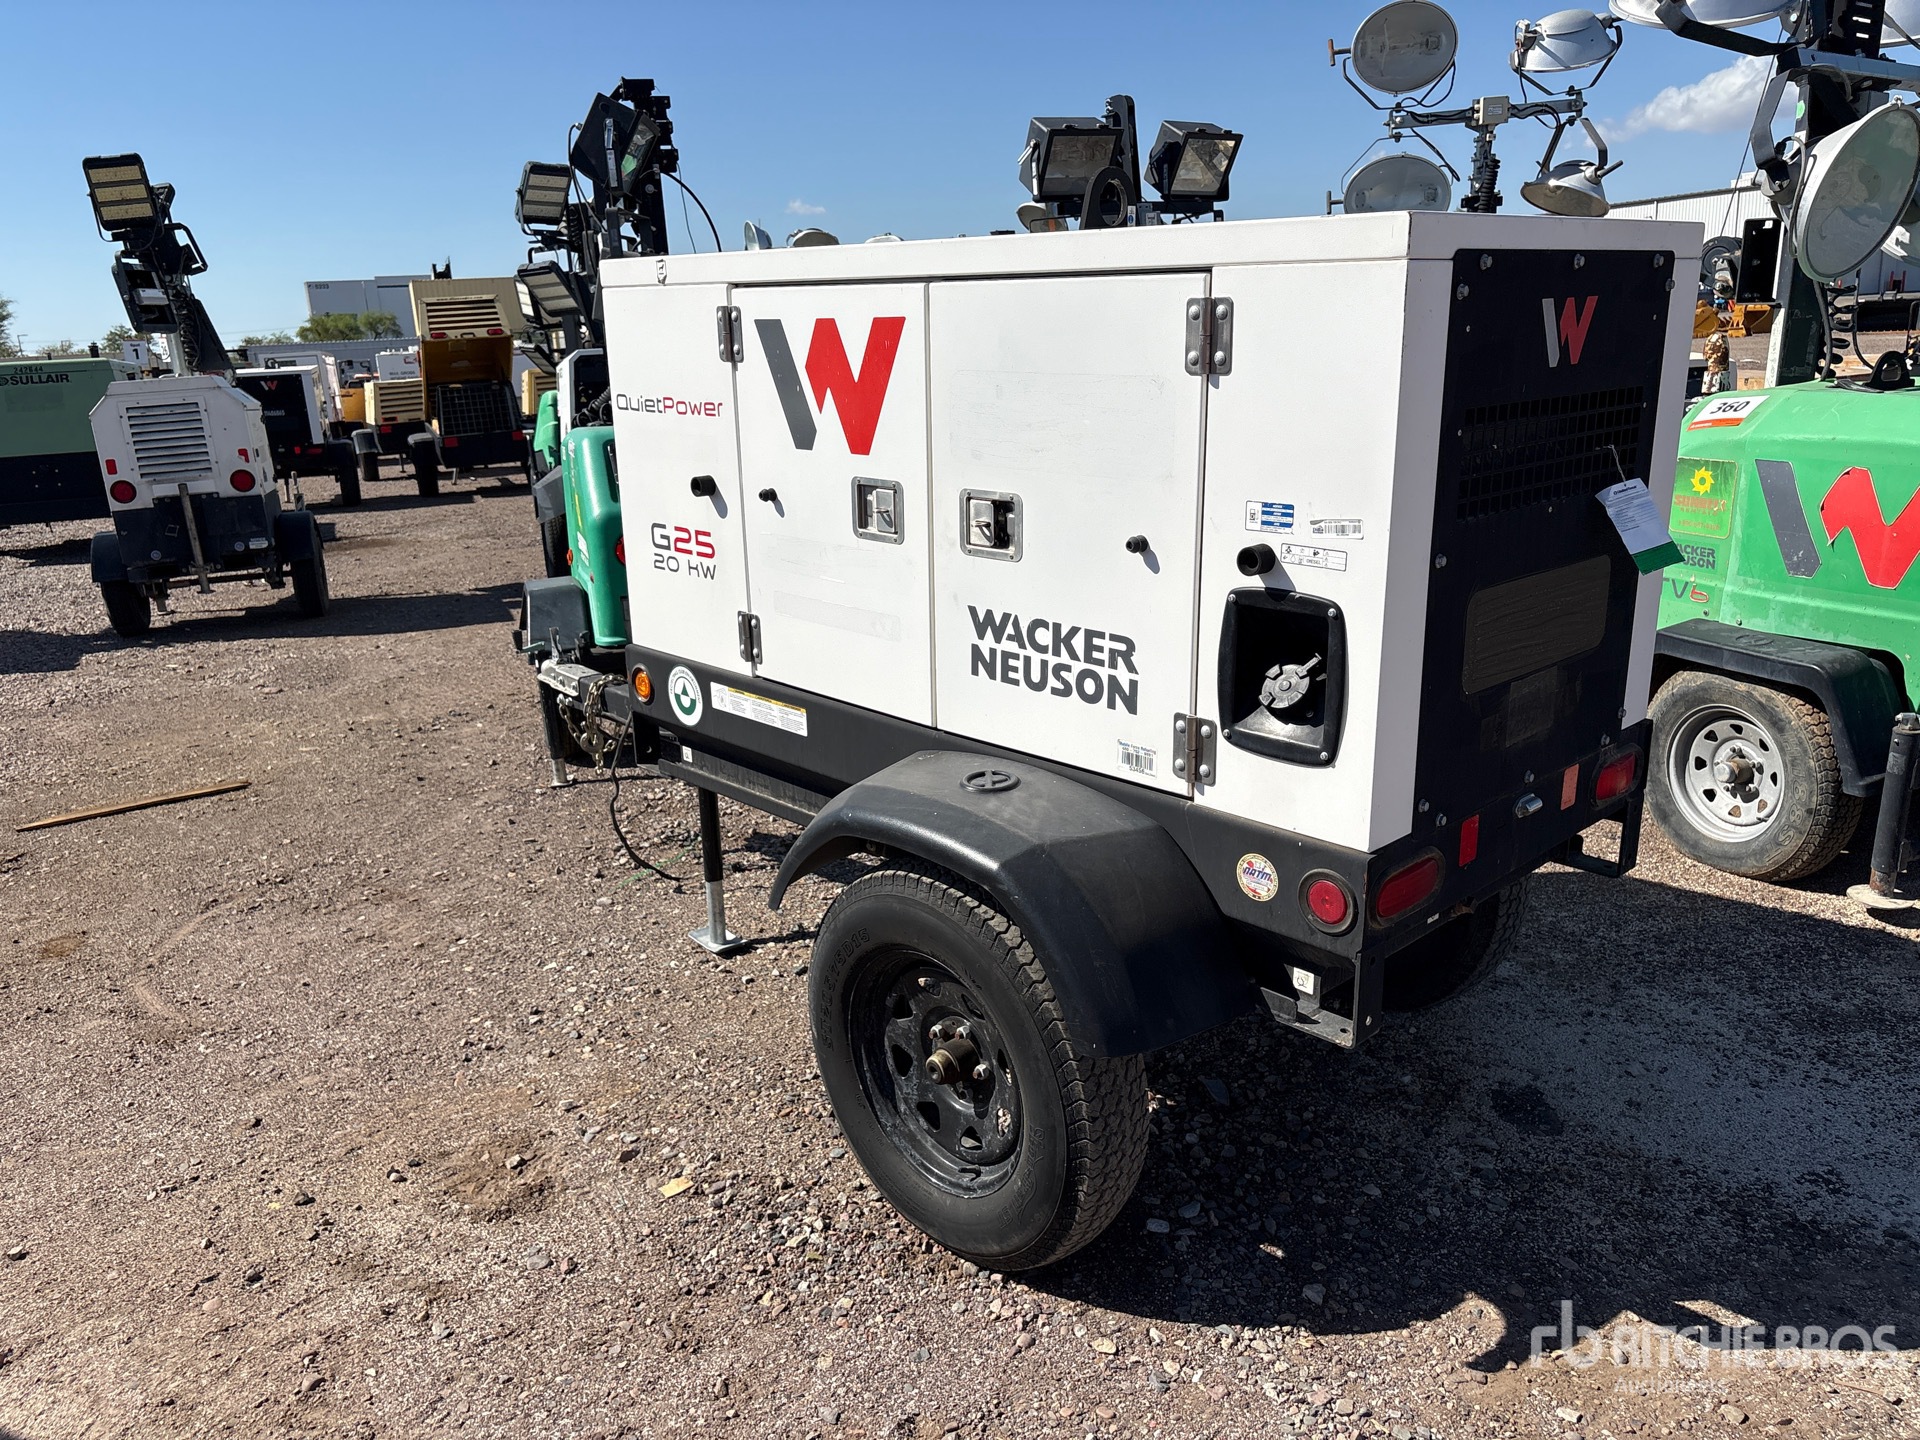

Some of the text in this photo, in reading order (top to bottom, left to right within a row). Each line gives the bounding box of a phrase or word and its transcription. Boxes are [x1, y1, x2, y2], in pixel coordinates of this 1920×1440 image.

[10, 373, 70, 387] SULLAIR
[616, 393, 724, 418] QuietPower
[1709, 400, 1751, 415] 360
[651, 522, 716, 559] G25
[653, 552, 680, 573] 20
[967, 604, 1140, 676] WACKER
[970, 643, 1139, 716] NEUSON
